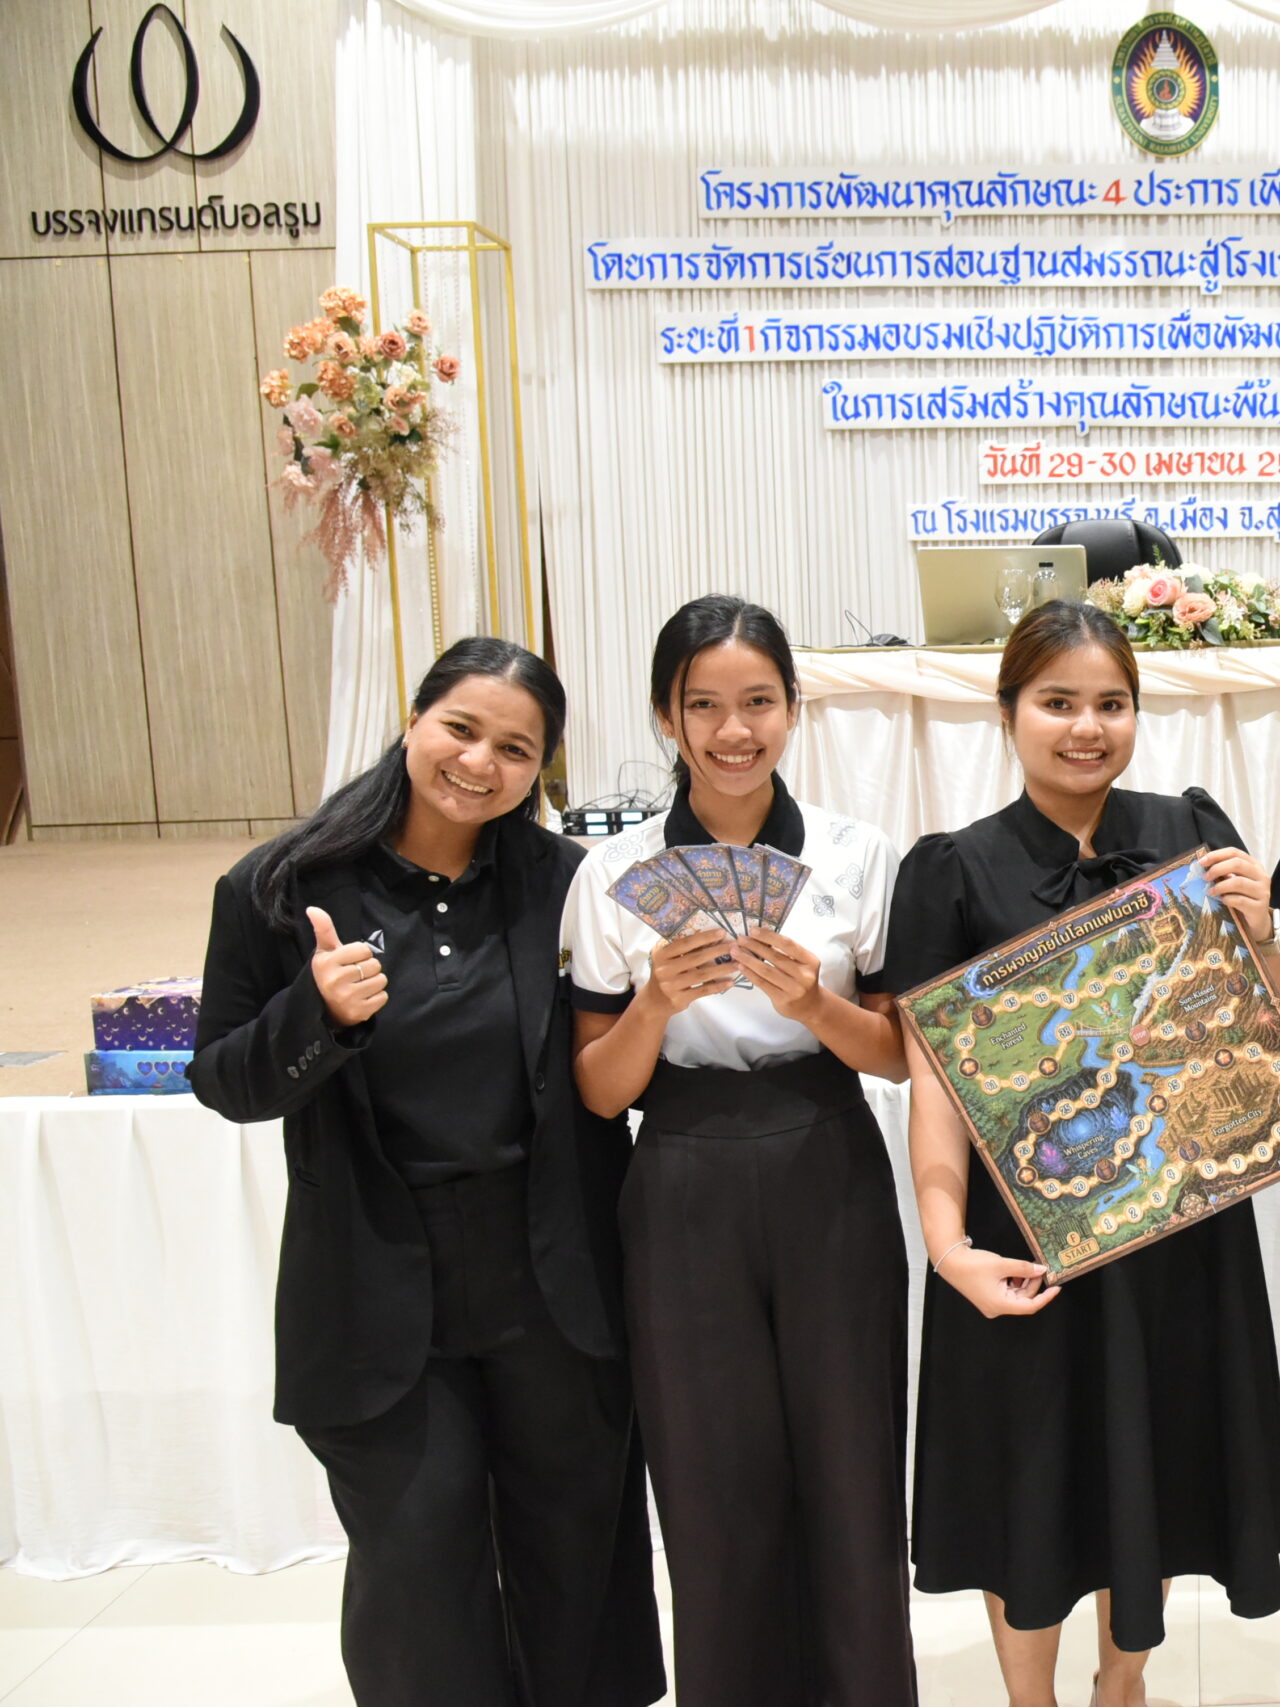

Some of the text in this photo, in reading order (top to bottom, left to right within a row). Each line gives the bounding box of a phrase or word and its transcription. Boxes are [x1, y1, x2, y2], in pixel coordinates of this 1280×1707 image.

[700, 169, 1097, 222] โครงการพัฒนาคุณลักษณะ
[1102, 179, 1128, 206] 4
[1133, 170, 1242, 207] ประการ
[30, 195, 322, 239] บรรจงแกรนด์บอลรูม
[984, 441, 1041, 478] วันที่
[1047, 451, 1137, 478] 29-30
[1145, 451, 1248, 477] เมษายน
[911, 508, 939, 536] ณ
[982, 893, 1149, 987] การผจญภัยในโลกแฟนตาซี
[1179, 984, 1215, 1005] Sun-Kissed
[1184, 993, 1217, 1013] Mountains
[991, 1023, 1027, 1046] Enchanted
[1001, 1035, 1024, 1051] Forest
[1211, 1108, 1264, 1136] Forgotten City
[1063, 1135, 1105, 1156] Whispering
[1077, 1147, 1099, 1160] Caves
[1257, 1145, 1268, 1157] 8
[1204, 1162, 1214, 1174] 6
[1232, 1157, 1241, 1169] 7
[1151, 1192, 1162, 1204] 3
[1128, 1206, 1138, 1219] 2
[1103, 1218, 1113, 1230] 1
[1064, 1243, 1093, 1261] START
